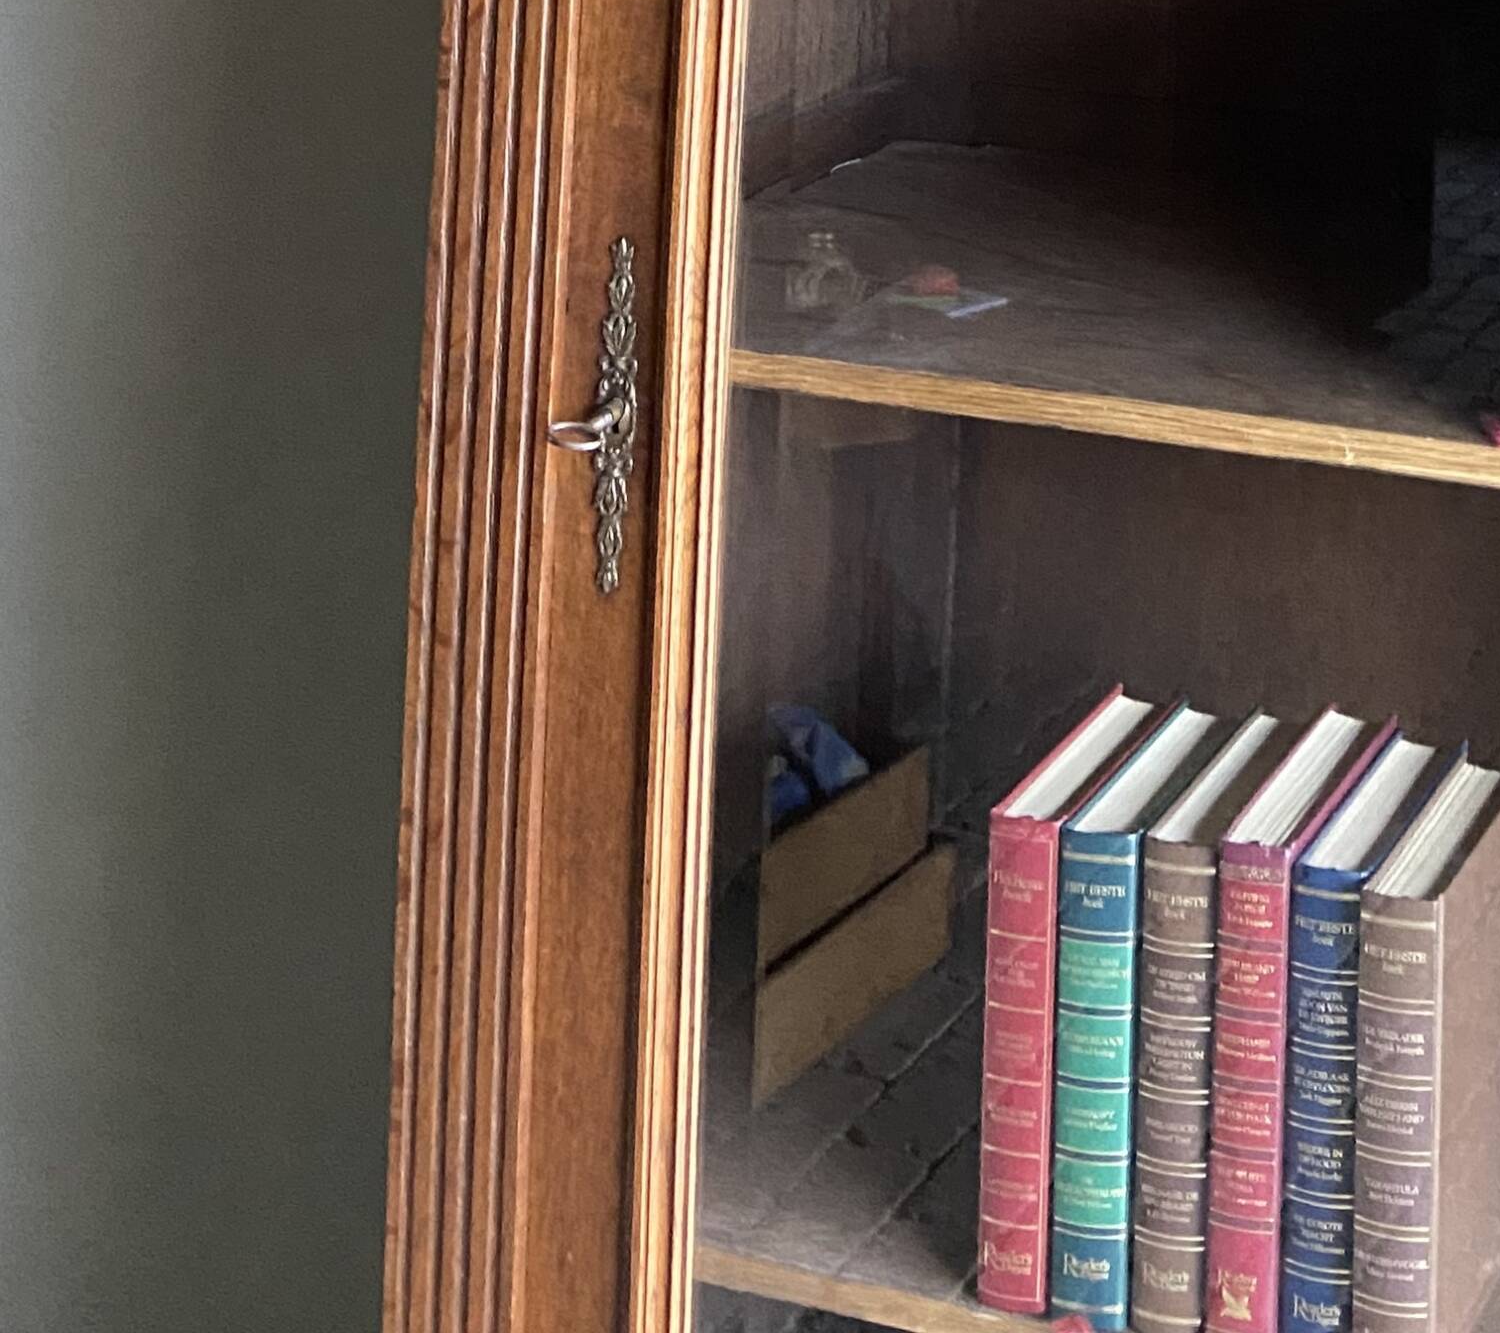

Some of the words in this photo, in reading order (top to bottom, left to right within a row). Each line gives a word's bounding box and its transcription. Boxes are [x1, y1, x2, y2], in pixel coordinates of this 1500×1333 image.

[1088, 883, 1127, 898] BESTE
[1171, 893, 1209, 909] BESTE
[1388, 948, 1427, 964] BESTE
